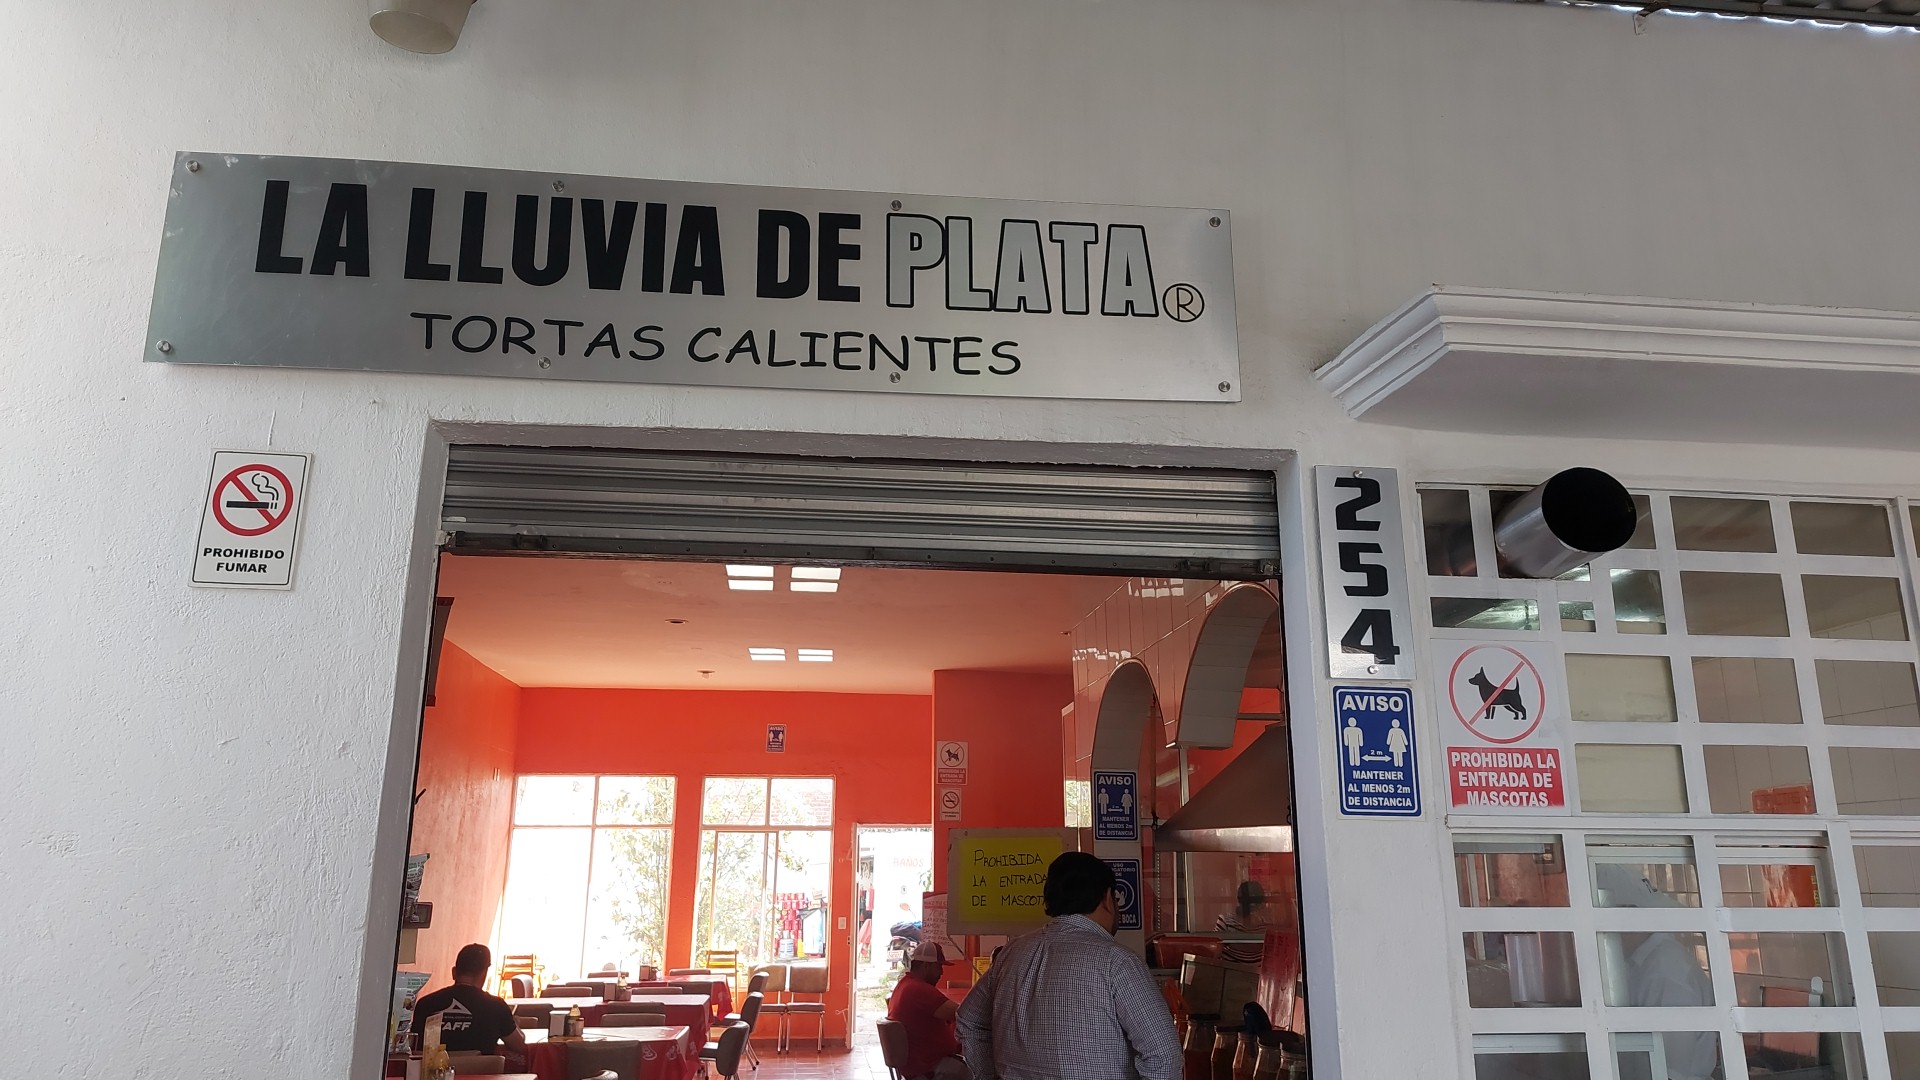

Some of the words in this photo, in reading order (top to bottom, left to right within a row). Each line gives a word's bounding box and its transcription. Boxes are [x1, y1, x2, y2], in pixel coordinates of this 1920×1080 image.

[255, 180, 370, 277] LA
[403, 187, 725, 296] LLUVIA
[756, 209, 861, 303] DE
[886, 213, 1159, 318] PLATA
[410, 312, 665, 361] TORTAS
[688, 327, 1022, 376] CALIENTES
[203, 547, 285, 560] PROHIBIDO
[216, 562, 267, 573] FUMAR
[1334, 477, 1400, 665] 254
[1342, 695, 1404, 712] AVISO
[1451, 751, 1534, 769] PROHIBIDA
[1536, 753, 1557, 769] LA
[1098, 775, 1132, 786] AVISO
[1352, 770, 1404, 780] MANTENER
[1458, 771, 1530, 788] ENTRADA
[1532, 772, 1553, 788] DE
[1347, 783, 1360, 792] AL
[1361, 783, 1395, 793] MENOS
[1396, 784, 1411, 794] 2m
[1348, 796, 1361, 806] DE
[1362, 797, 1413, 807] DISTANCIA
[1466, 790, 1549, 807] MASCOTAS
[972, 874, 987, 887] LA
[999, 873, 1048, 888] ENTRADA
[971, 895, 987, 907] DE
[1001, 894, 1045, 906] MASCOT
[1121, 914, 1137, 924] BOCA
[441, 1021, 472, 1031] AFF
